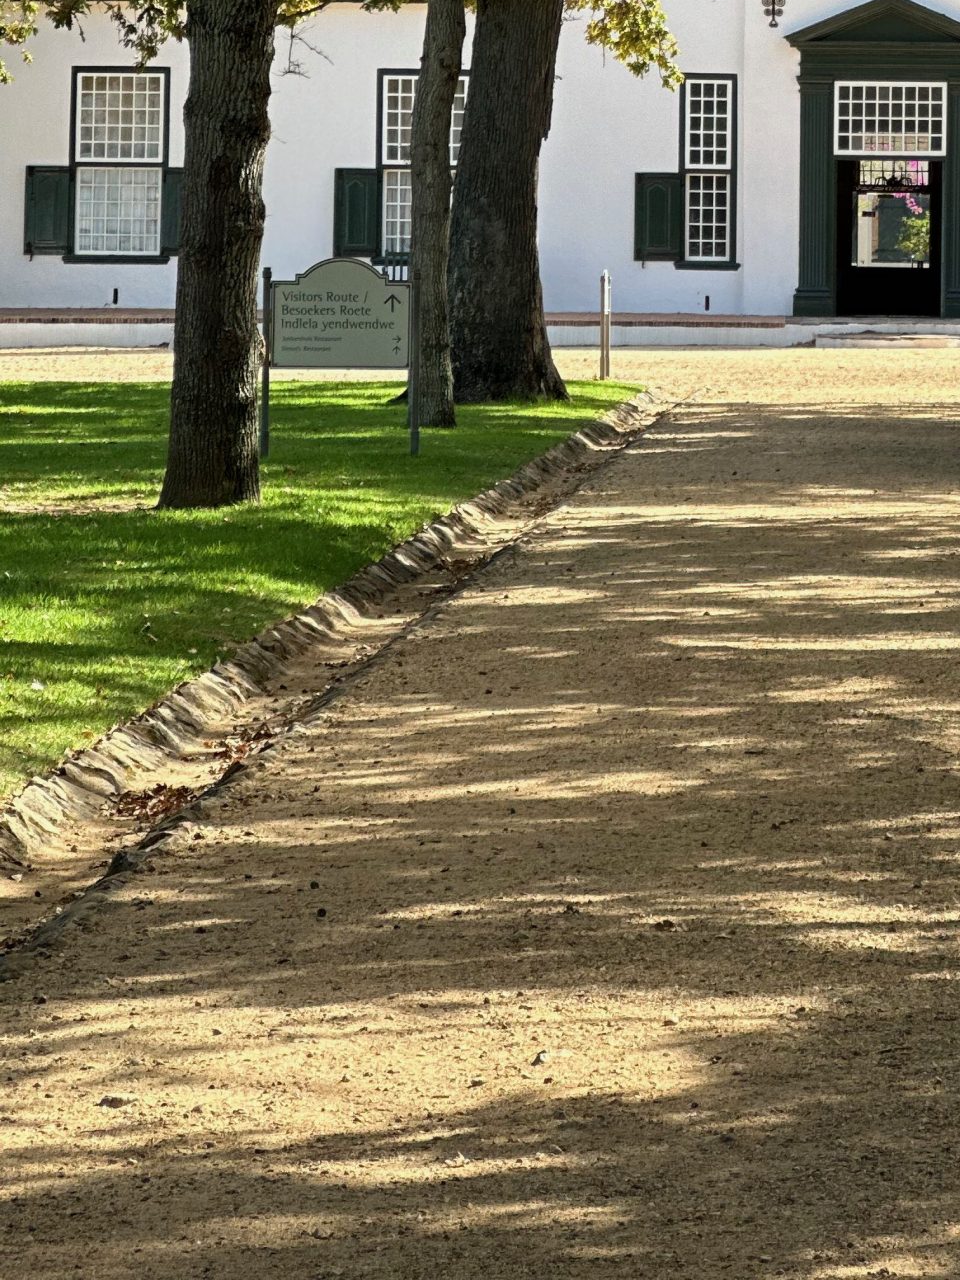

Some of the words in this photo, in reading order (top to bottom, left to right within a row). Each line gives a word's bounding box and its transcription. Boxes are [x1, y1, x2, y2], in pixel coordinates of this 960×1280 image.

[282, 291, 322, 302] Visitors
[326, 291, 359, 302] Route
[363, 291, 368, 303] /
[281, 304, 336, 316] Besoekers
[340, 304, 371, 316] Roete
[281, 318, 318, 329] Indlela
[321, 318, 395, 332] yendwendwe
